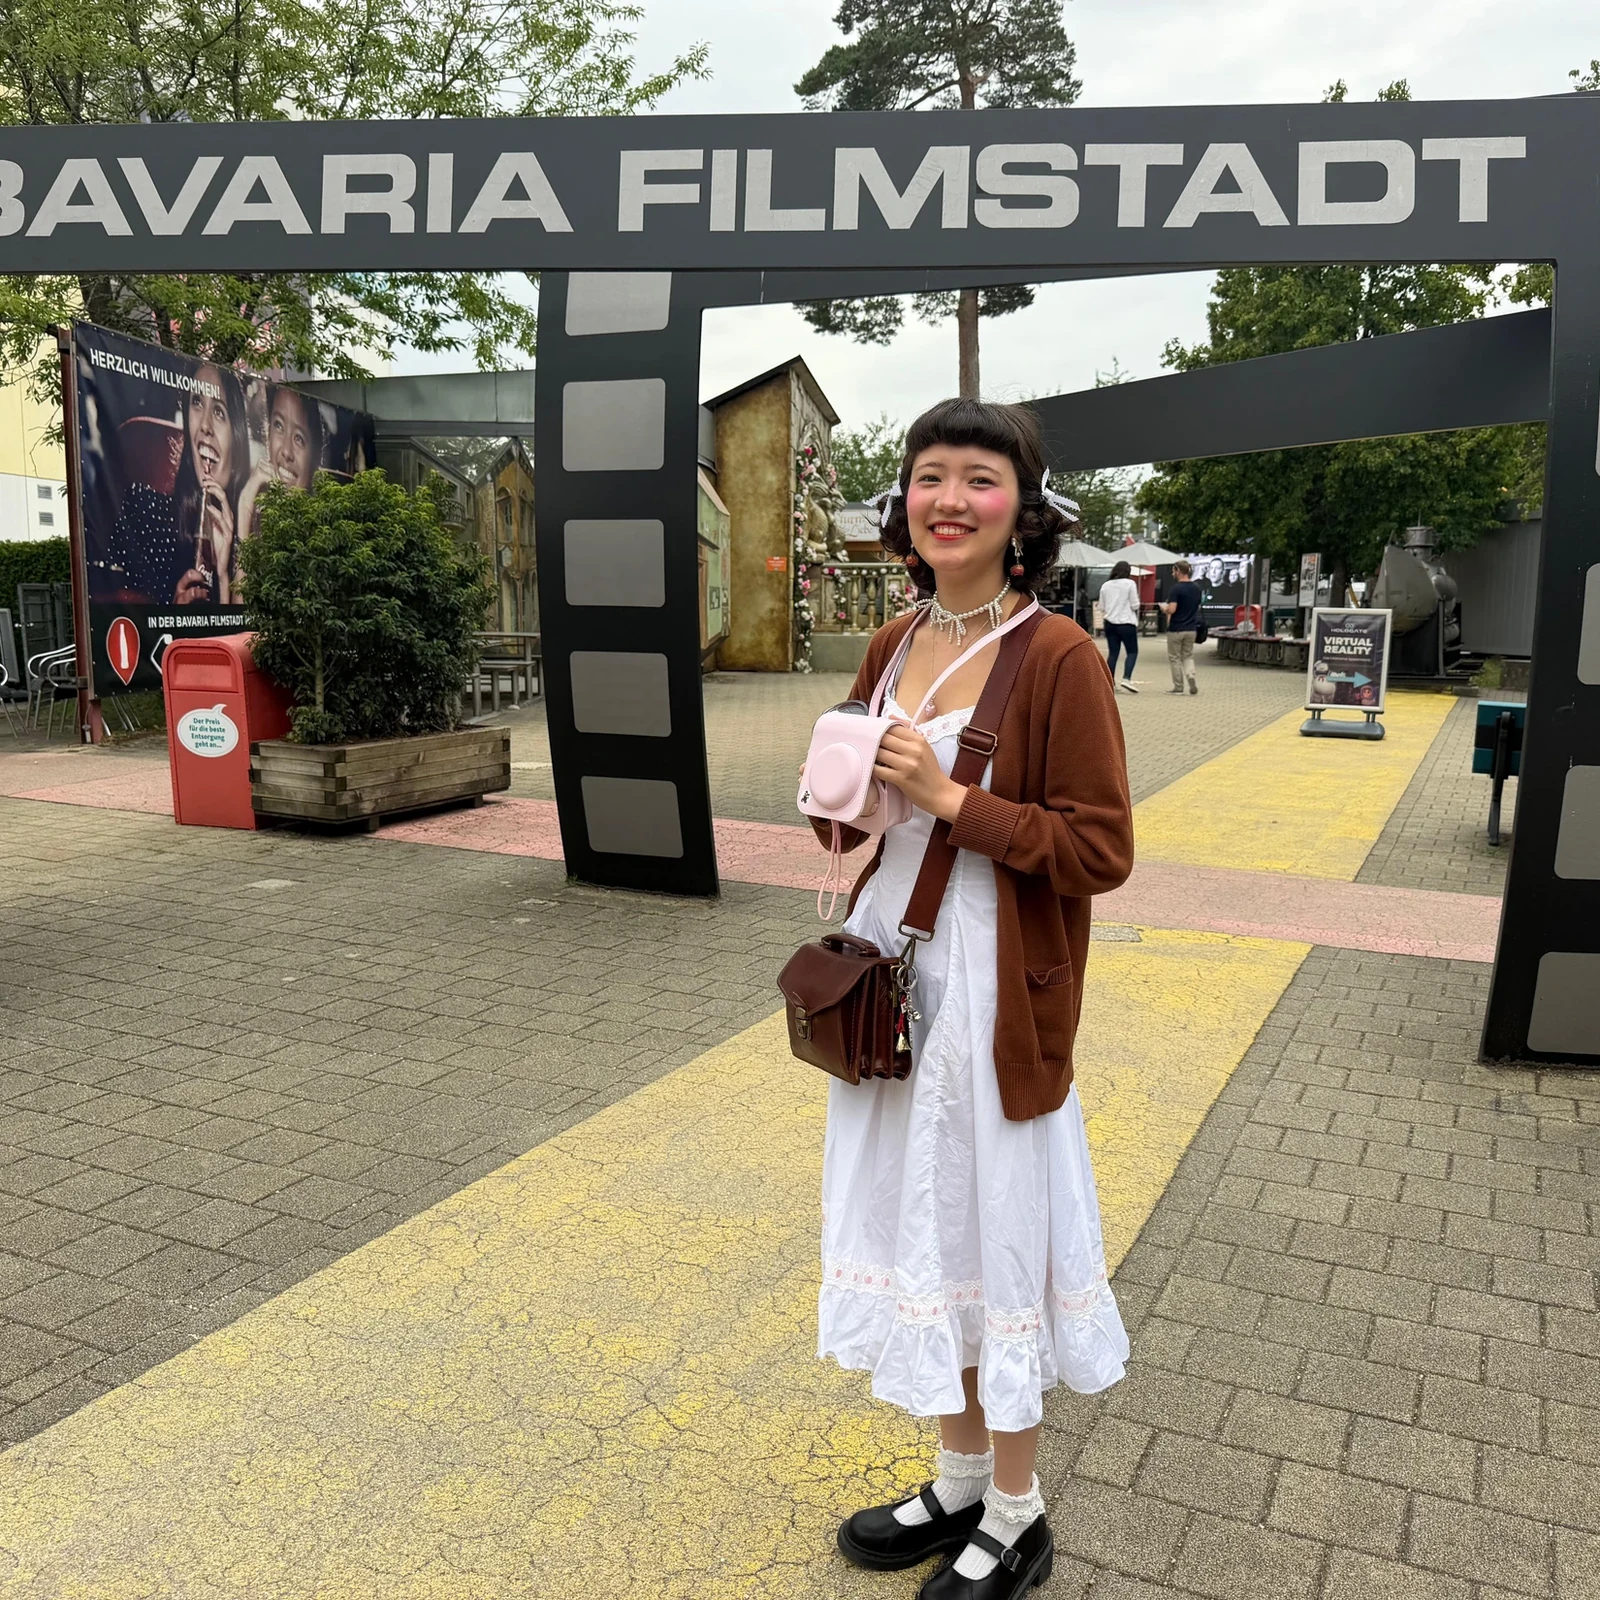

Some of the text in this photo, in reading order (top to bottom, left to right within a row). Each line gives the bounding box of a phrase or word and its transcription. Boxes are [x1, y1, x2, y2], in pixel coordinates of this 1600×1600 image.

[0, 136, 1527, 237] AVARIA FILMSTADT
[90, 348, 221, 400] HERZLICH WILLKOMMEN!
[148, 616, 157, 628] IN
[158, 616, 175, 628] DER
[176, 615, 210, 627] BAVARIA
[210, 614, 244, 626] FILMSTADT
[1324, 636, 1373, 646] VIRTUAL
[1324, 645, 1372, 655] REALITY
[191, 733, 225, 742] Entsorgung
[195, 741, 208, 749] geht
